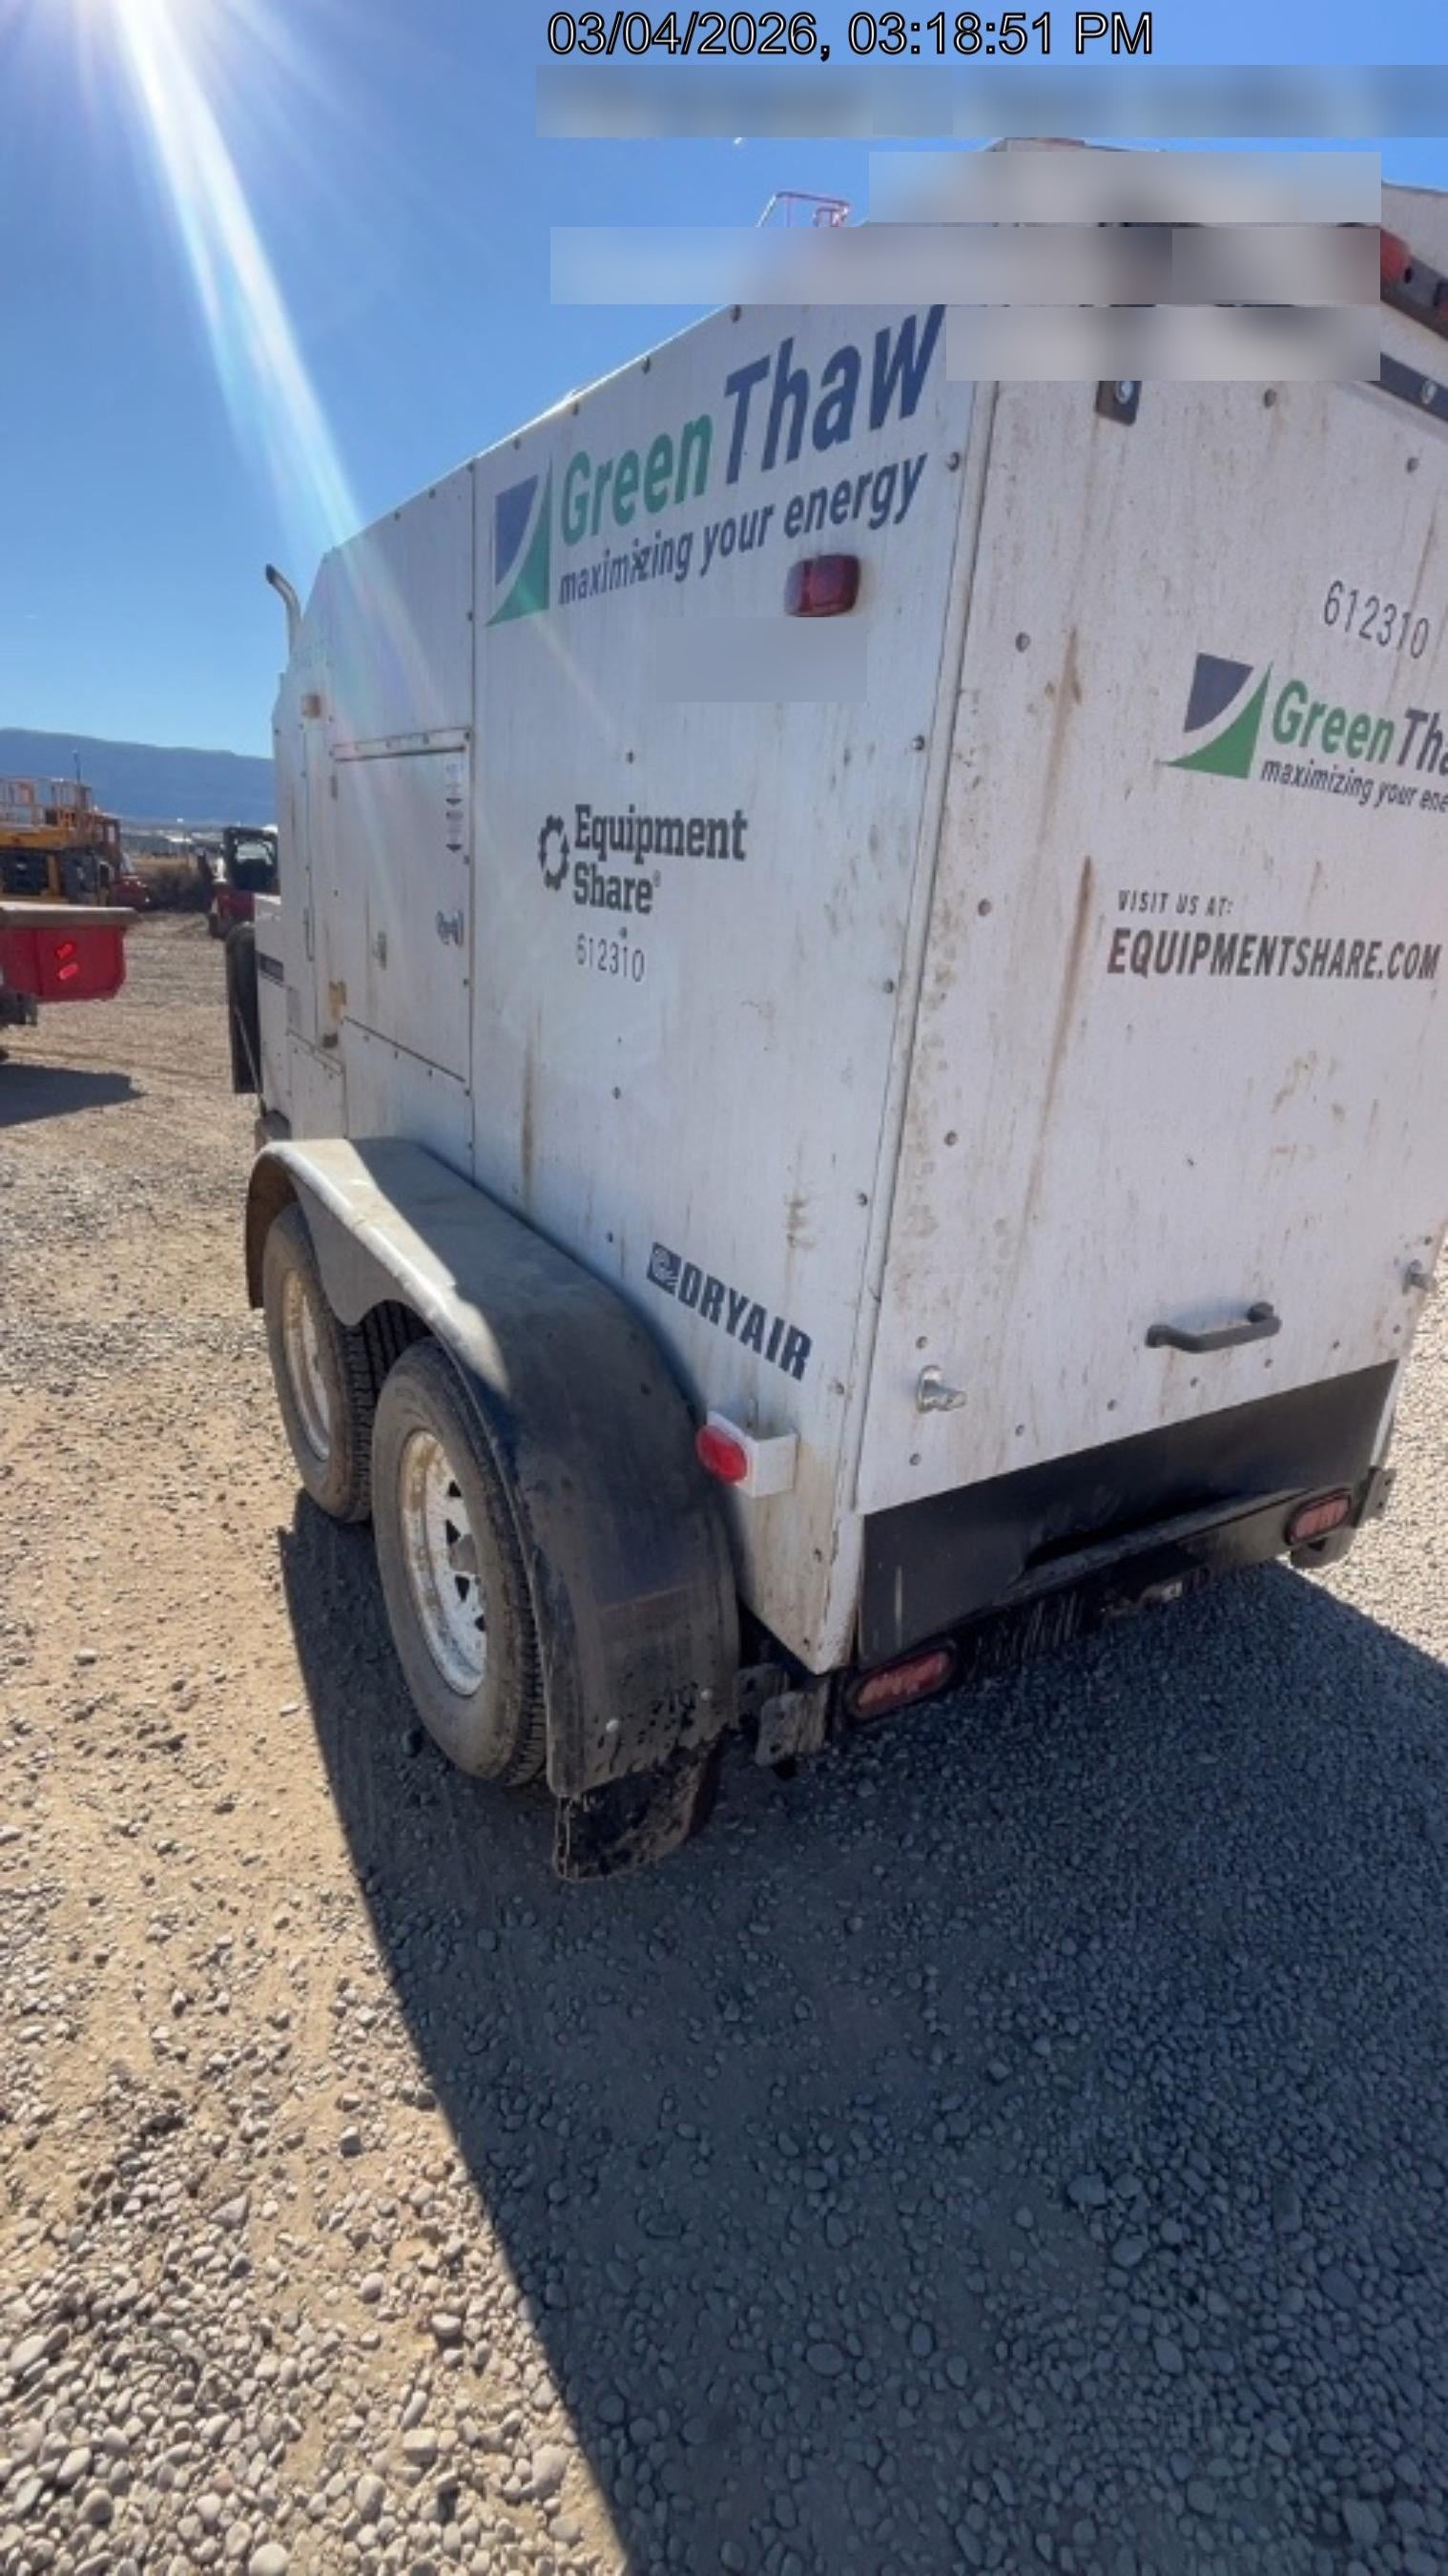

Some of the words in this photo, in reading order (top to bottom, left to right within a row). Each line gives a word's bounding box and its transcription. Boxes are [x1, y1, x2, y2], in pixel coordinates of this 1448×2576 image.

[558, 529, 694, 605] maximizing
[700, 504, 776, 577] your
[784, 453, 927, 537] energy
[1324, 579, 1431, 659] 612310
[1260, 758, 1375, 806] maximizing
[1374, 782, 1418, 809] your
[574, 804, 748, 864] Equipment
[1117, 889, 1169, 914] VISIT
[1175, 893, 1199, 916] US
[1205, 896, 1234, 917] AT:
[1107, 926, 1442, 980] EQUIPMENTSHARE.COM
[678, 1262, 813, 1381] DRYAIR
